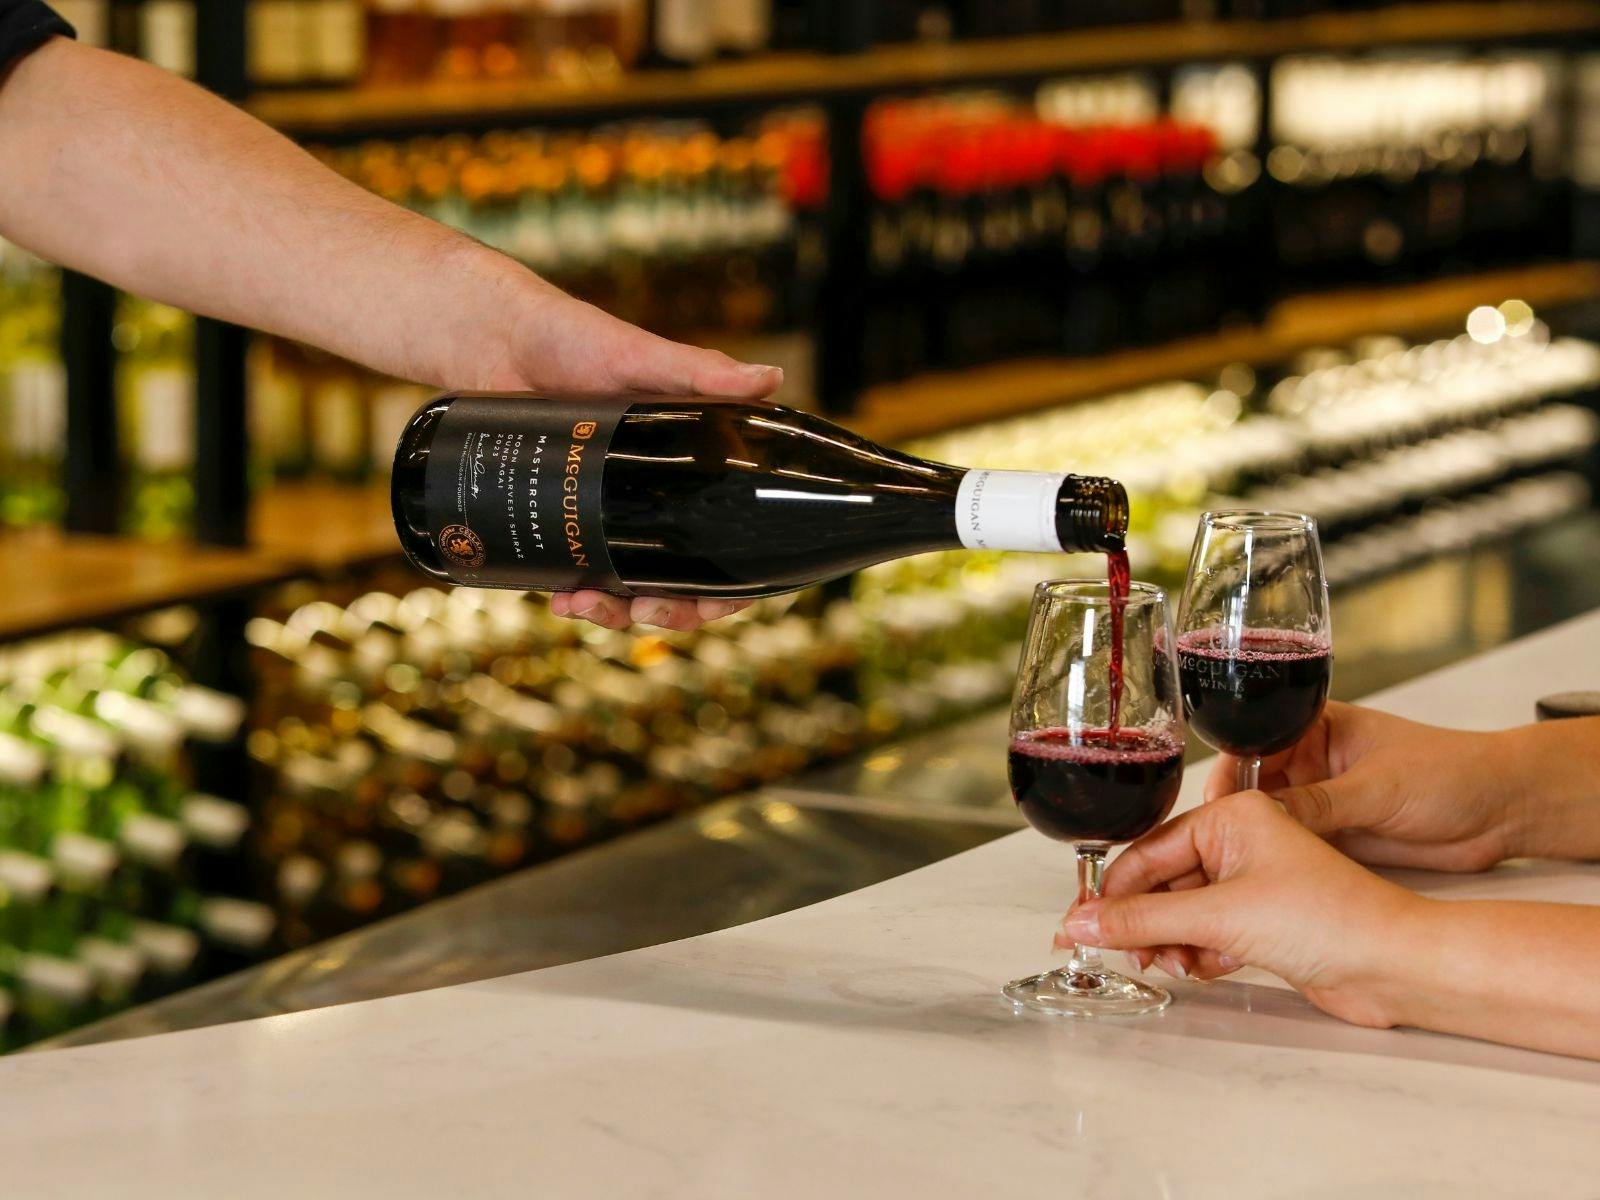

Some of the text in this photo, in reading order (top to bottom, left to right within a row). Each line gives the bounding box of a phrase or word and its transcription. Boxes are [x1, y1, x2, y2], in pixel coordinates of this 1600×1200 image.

[492, 434, 504, 457] 2023
[497, 434, 514, 488] GUNDAGAI
[510, 434, 523, 463] NOON
[529, 435, 547, 550] MASTERCRAFT
[563, 444, 589, 567] McGUIGAN
[509, 524, 524, 559] SHIRAZ
